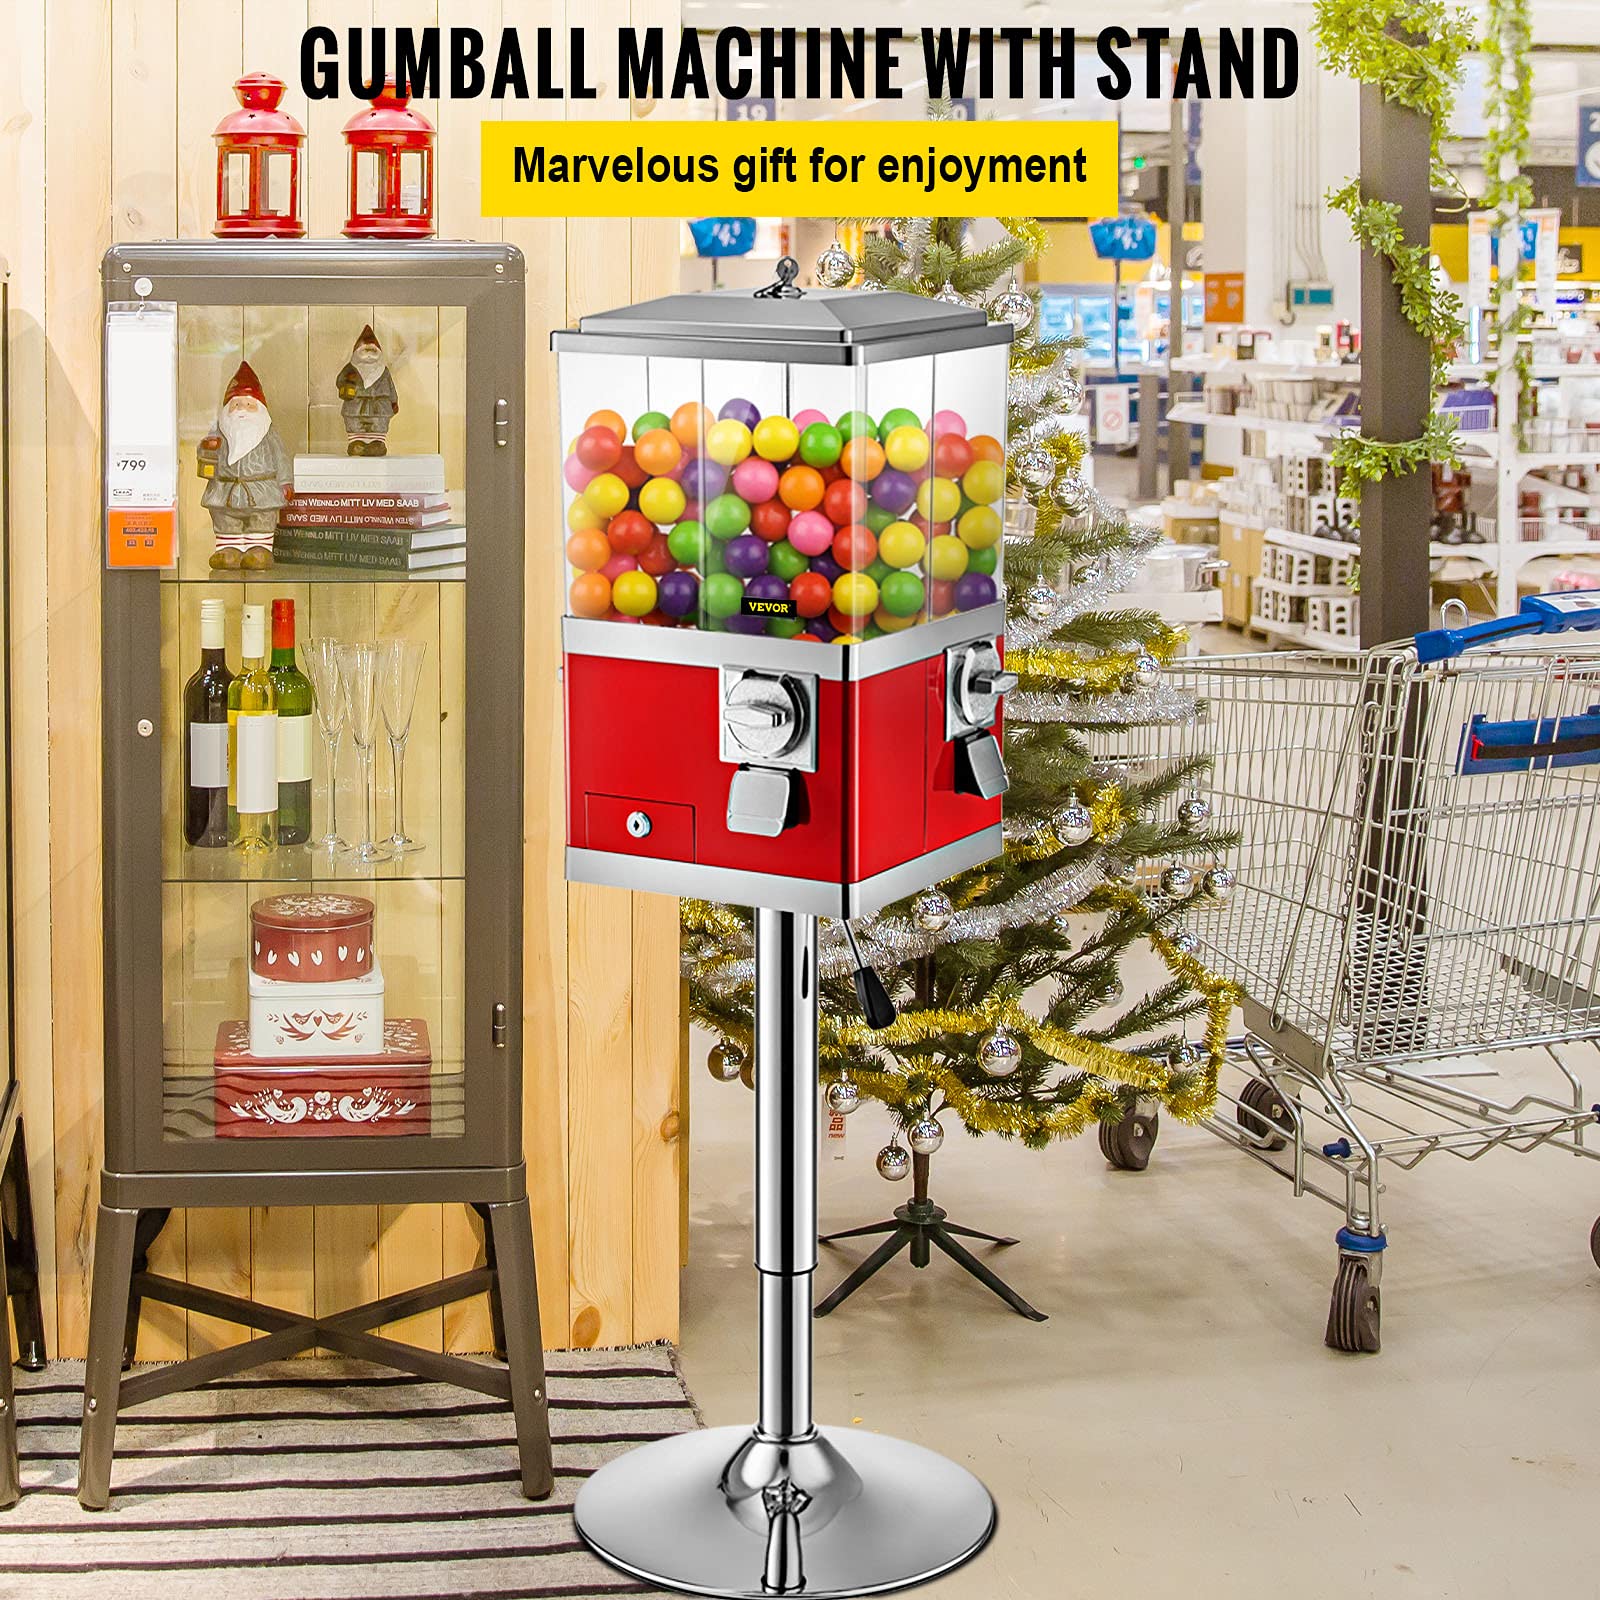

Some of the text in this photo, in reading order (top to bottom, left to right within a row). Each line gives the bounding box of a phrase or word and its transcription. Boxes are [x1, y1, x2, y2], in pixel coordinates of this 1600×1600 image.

[116, 459, 147, 471] ¥799
[341, 498, 361, 507] MITT
[362, 498, 375, 507] LIV
[376, 499, 395, 508] MED
[397, 499, 419, 508] SAAB
[286, 513, 308, 522] SAAB
[310, 514, 328, 523] MED
[329, 514, 343, 524] LIV
[344, 515, 363, 524] MITT
[325, 531, 346, 541] MITT
[360, 534, 379, 544] MED
[380, 536, 404, 546] SAAB
[748, 601, 789, 614] VEVOR
